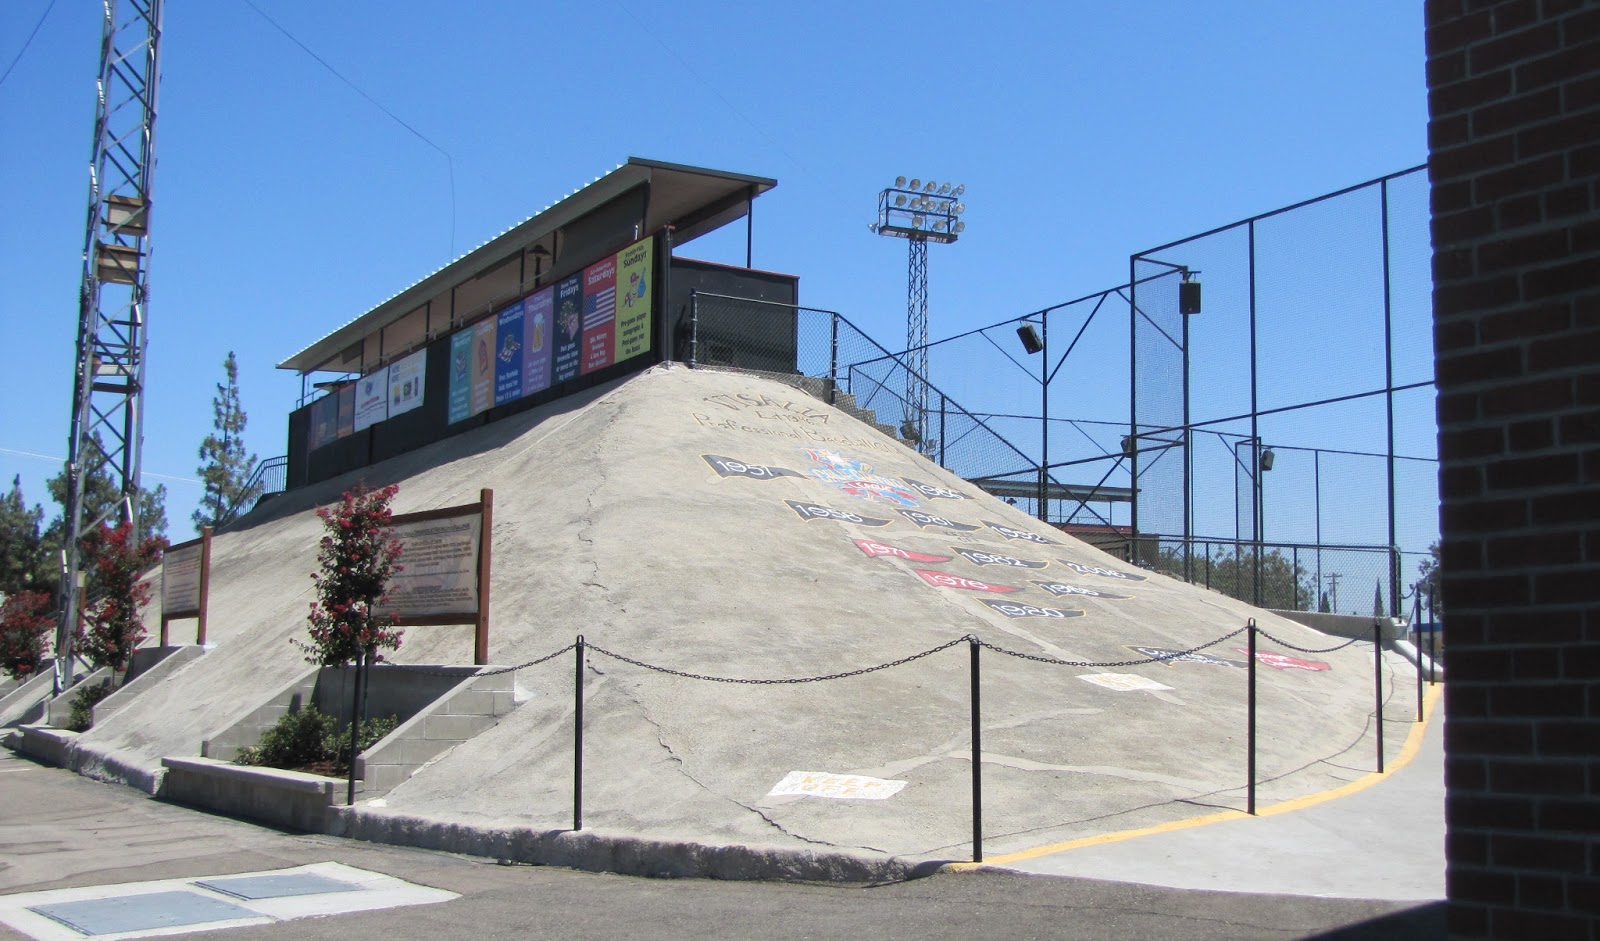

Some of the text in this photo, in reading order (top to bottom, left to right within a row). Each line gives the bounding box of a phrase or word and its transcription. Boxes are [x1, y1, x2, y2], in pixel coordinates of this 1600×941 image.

[623, 251, 648, 268] Sundays
[588, 267, 615, 285] Saturdays
[560, 284, 579, 298] Fridays
[861, 542, 910, 558] 1971
[991, 604, 1066, 618] 1980
